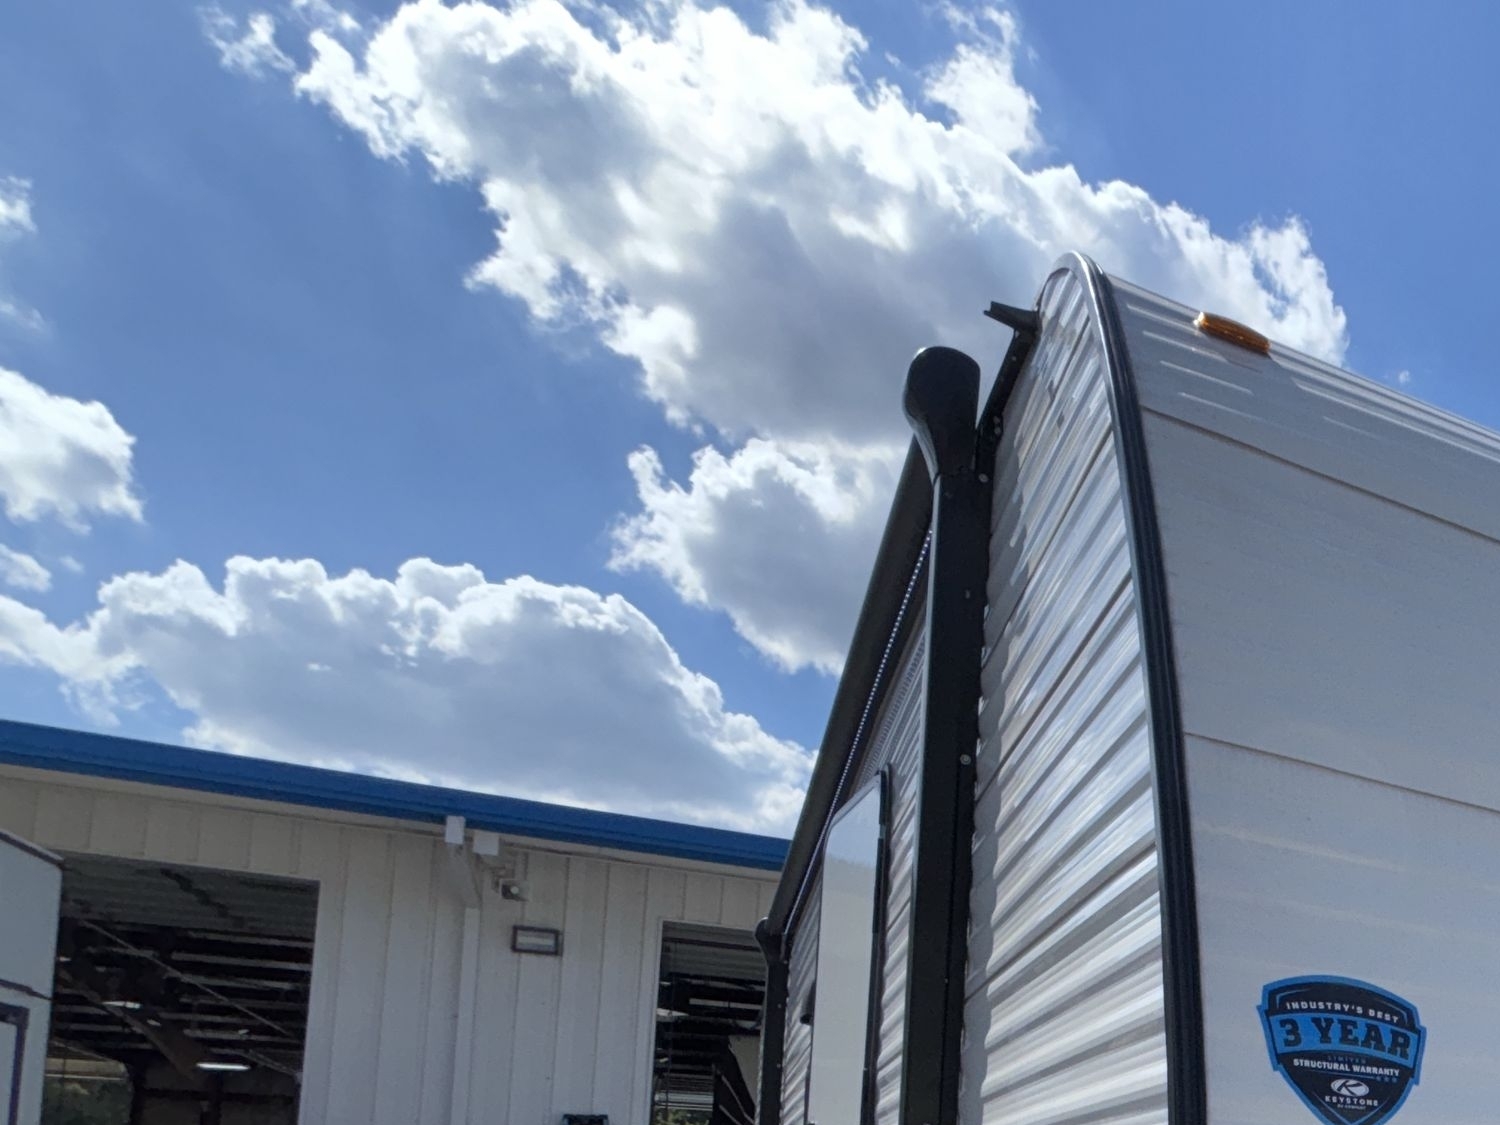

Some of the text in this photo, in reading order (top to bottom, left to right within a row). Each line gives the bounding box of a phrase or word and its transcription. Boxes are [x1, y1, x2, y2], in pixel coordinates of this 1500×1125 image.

[1286, 1001, 1399, 1023] INDUSTRY'S BEST
[1279, 1017, 1410, 1060] 3 YEAR
[1293, 1058, 1400, 1077] STRUCTURAL WARRANTY
[1325, 1095, 1378, 1106] KEYSTONE
